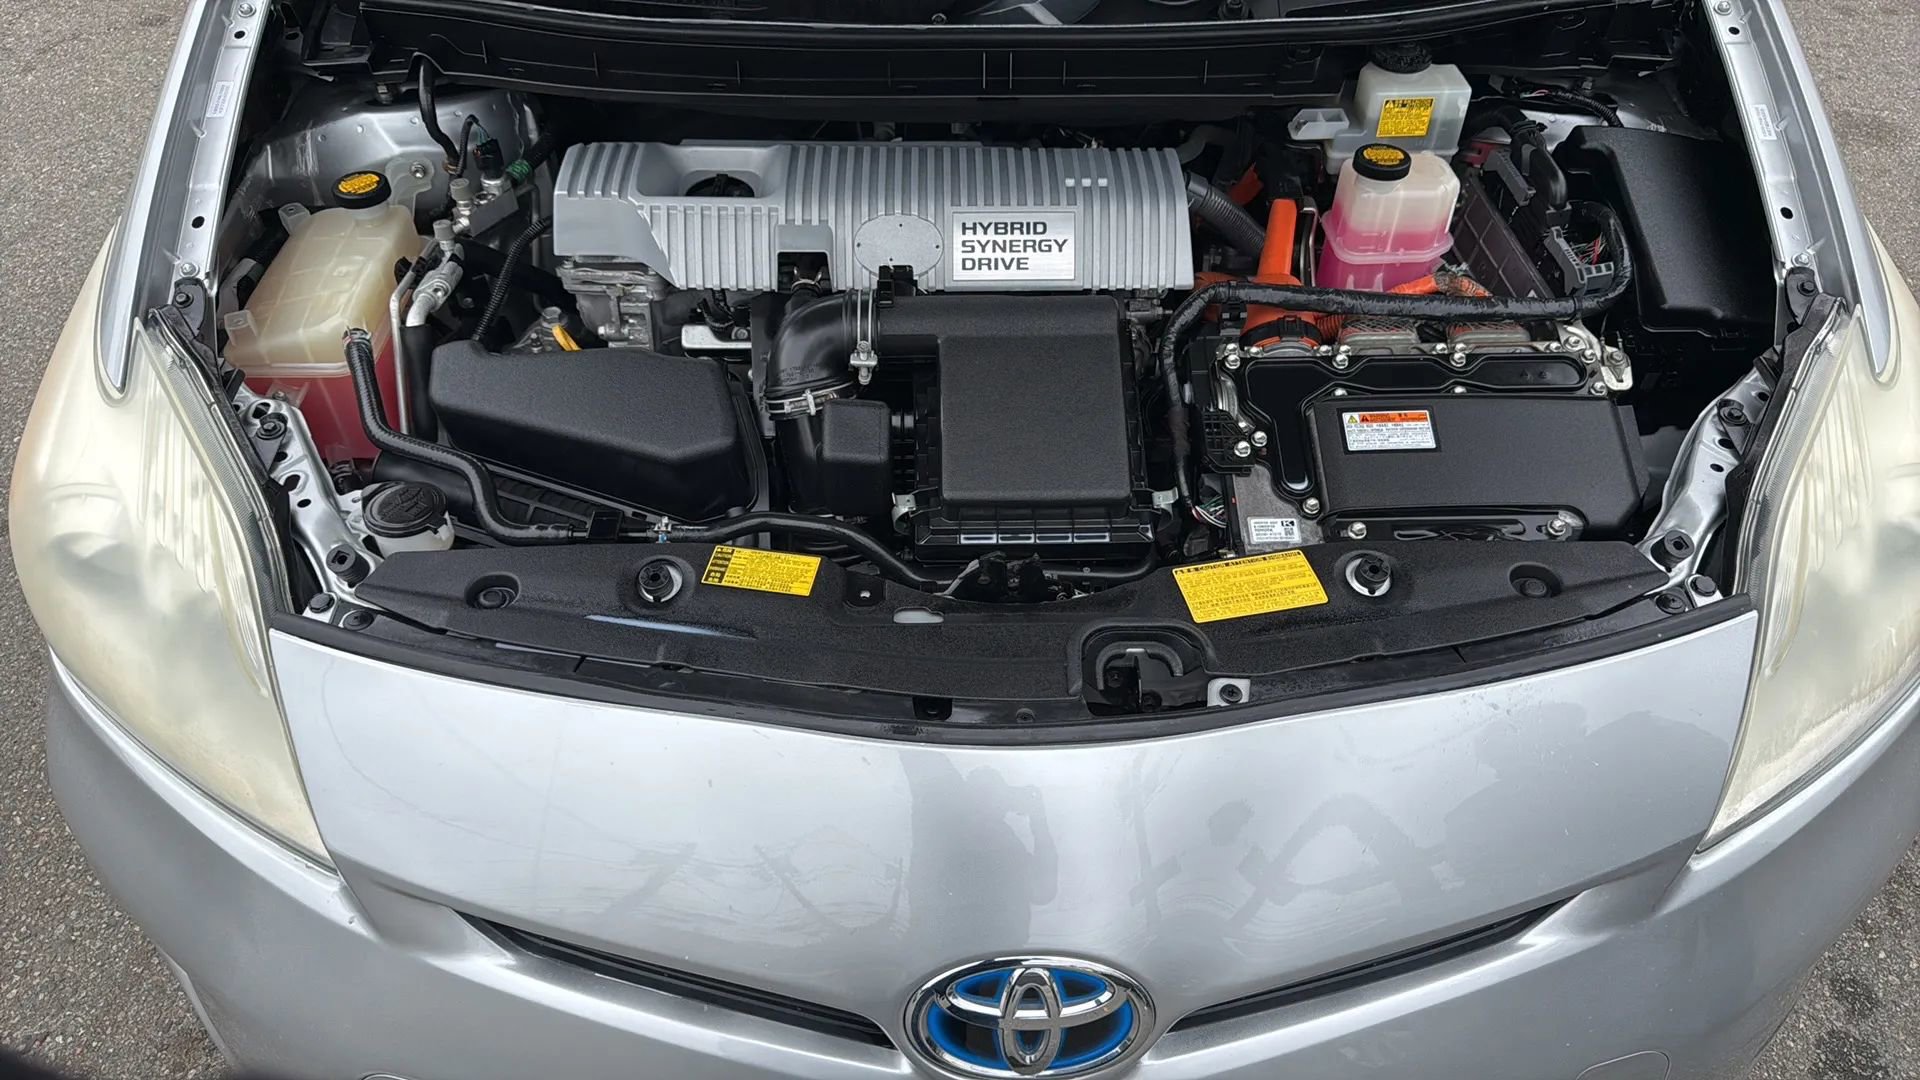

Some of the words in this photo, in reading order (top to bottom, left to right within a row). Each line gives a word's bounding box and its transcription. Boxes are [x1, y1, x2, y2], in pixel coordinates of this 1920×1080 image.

[961, 221, 1047, 235] HYBRID
[961, 239, 1068, 253] SYNERGY
[961, 257, 1029, 271] DRIVE
